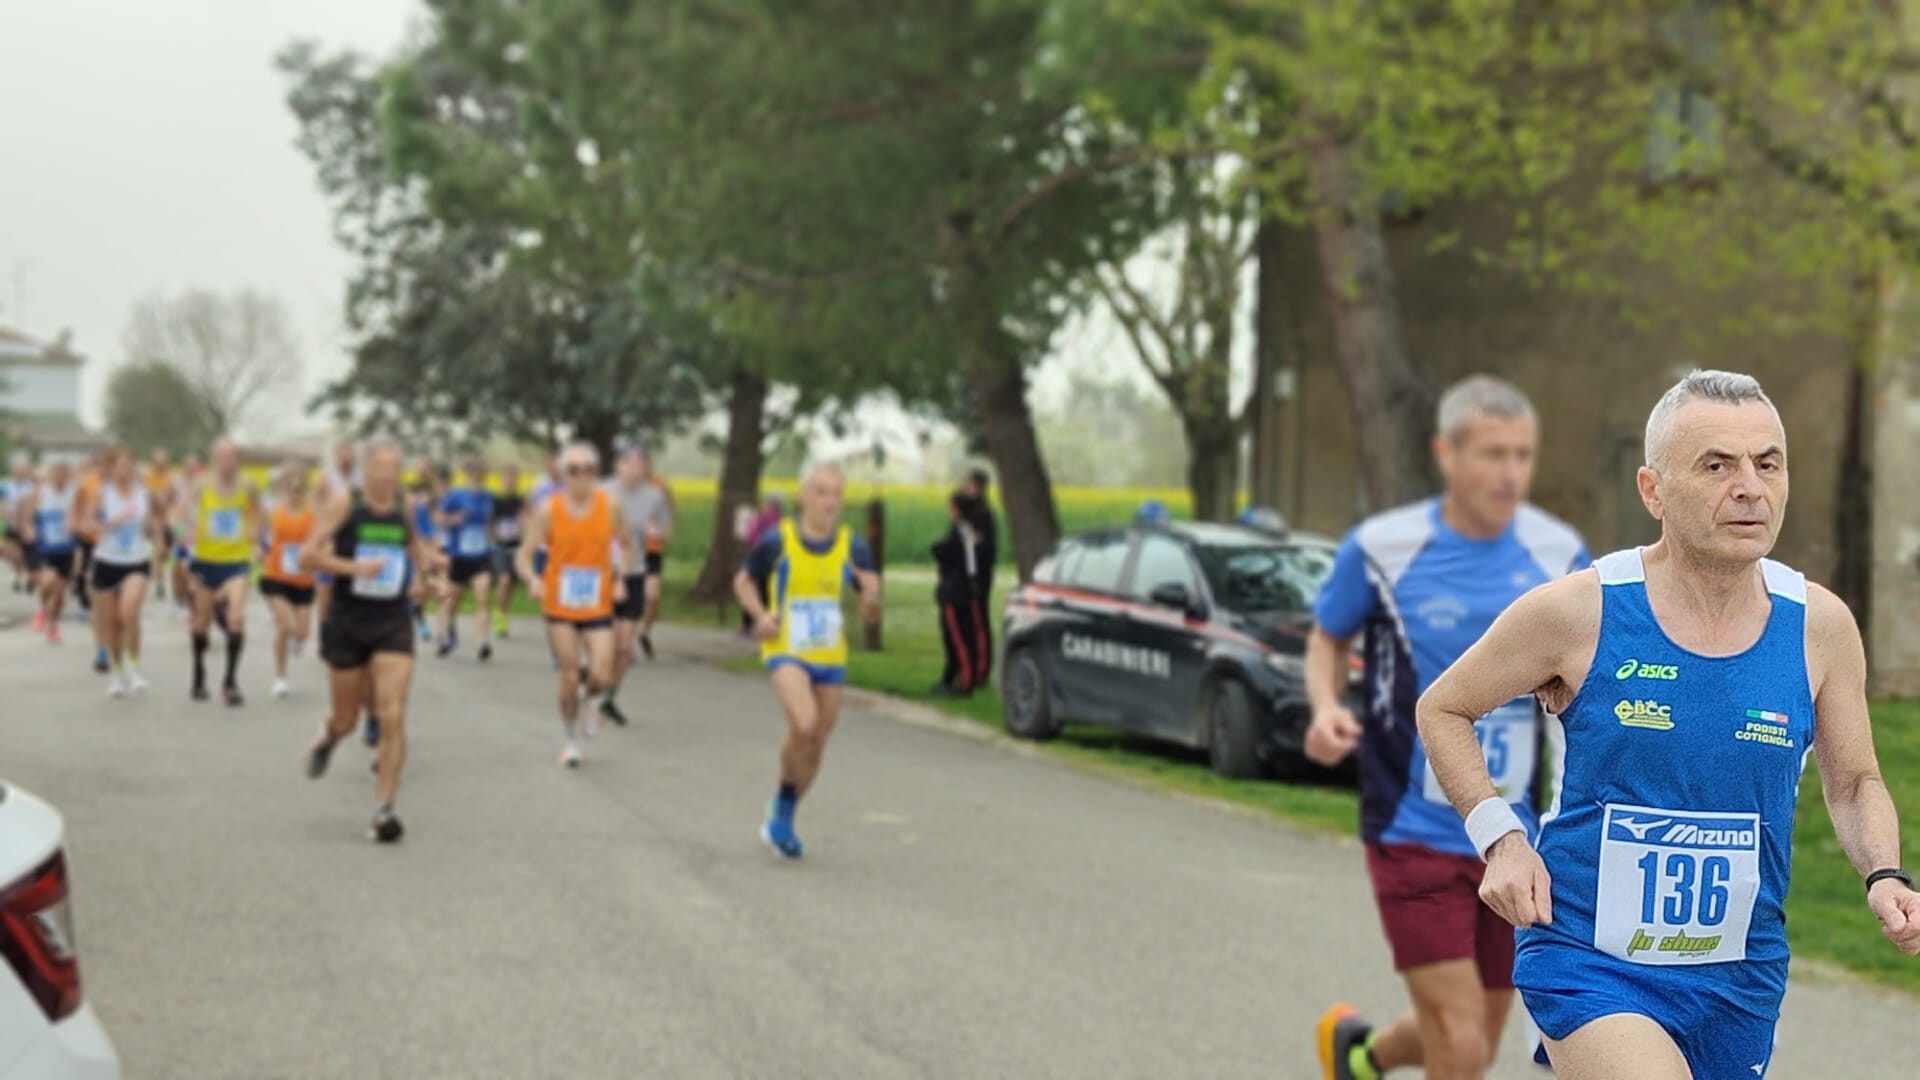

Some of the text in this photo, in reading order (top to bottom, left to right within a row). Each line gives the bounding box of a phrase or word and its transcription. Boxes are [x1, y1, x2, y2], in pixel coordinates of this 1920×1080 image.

[1062, 631, 1171, 679] CARABINIERI
[1637, 663, 1678, 680] asics
[1633, 700, 1672, 718] BCC
[1746, 722, 1787, 737] PODISTI
[1735, 730, 1794, 748] COTIGNOLA
[1638, 851, 1730, 927] 136
